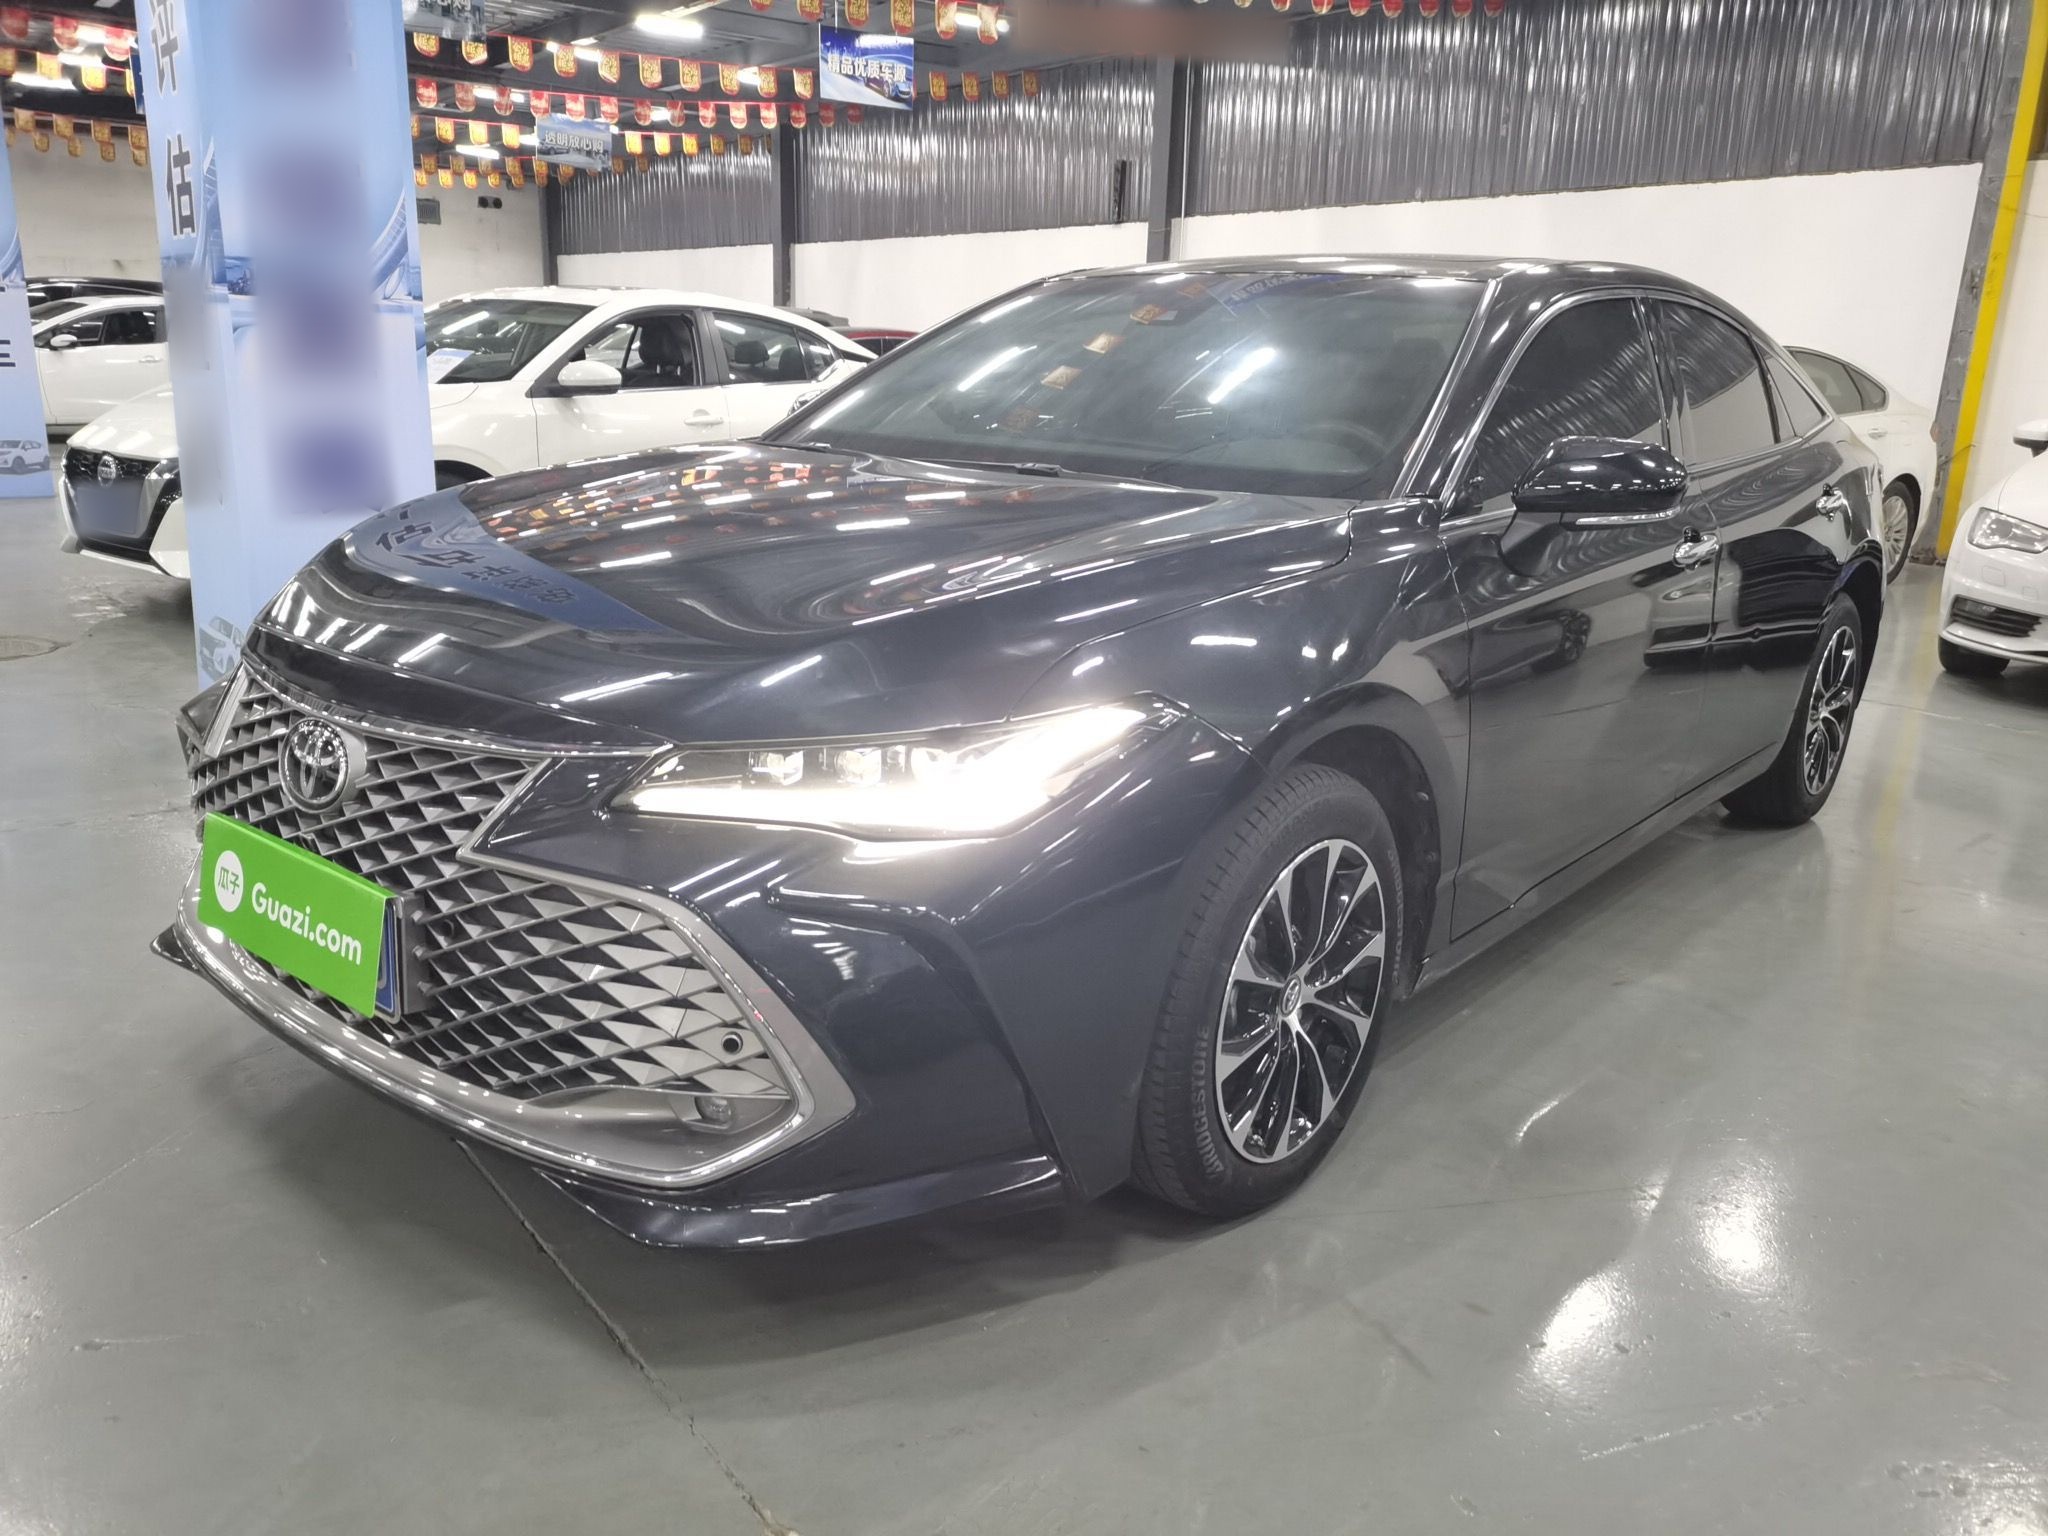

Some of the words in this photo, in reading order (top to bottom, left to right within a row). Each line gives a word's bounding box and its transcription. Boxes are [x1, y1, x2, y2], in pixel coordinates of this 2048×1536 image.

[827, 53, 907, 83] 精品优质车源
[545, 130, 604, 153] 透明放心购
[218, 866, 240, 895] 瓜子
[251, 882, 362, 966] Guazi.com
